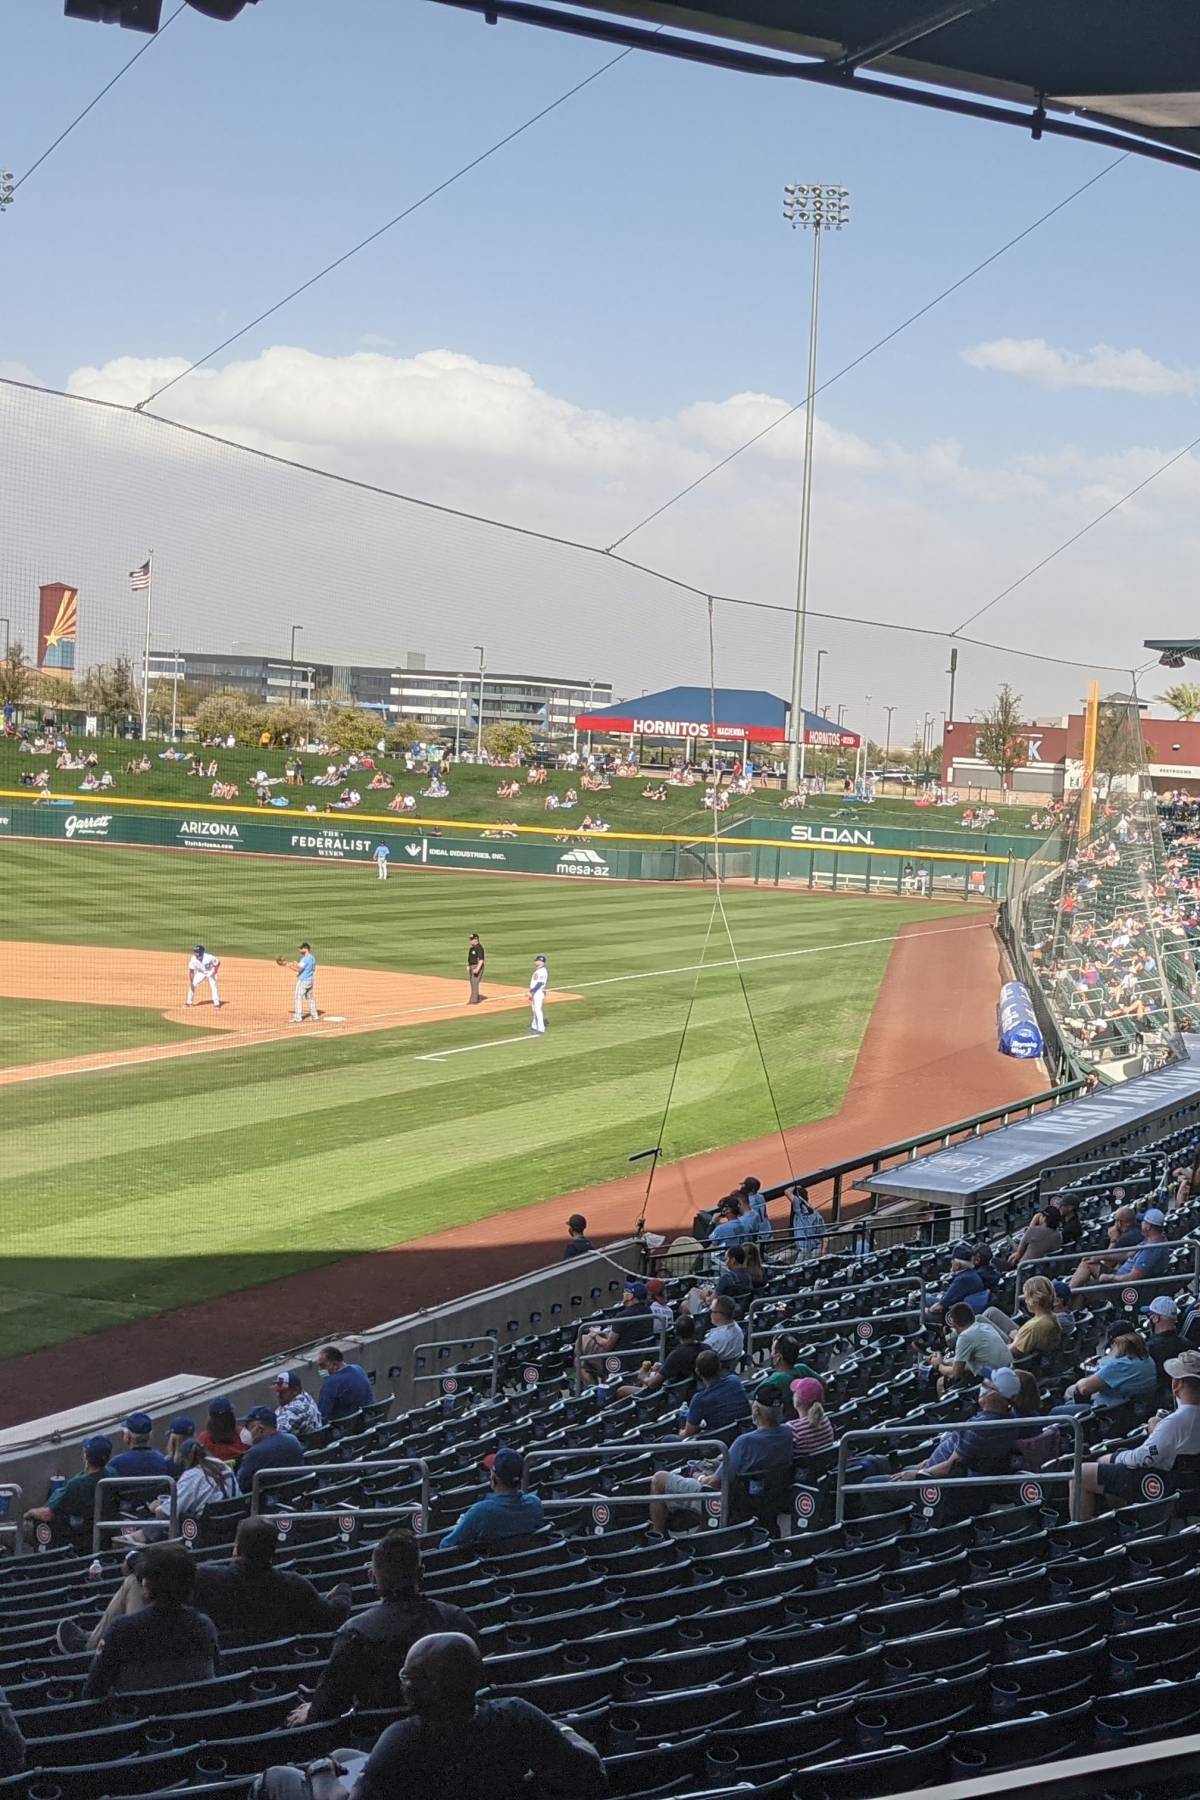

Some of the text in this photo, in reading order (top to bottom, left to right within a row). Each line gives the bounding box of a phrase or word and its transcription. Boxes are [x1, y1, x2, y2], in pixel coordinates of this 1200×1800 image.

[633, 719, 709, 738] HORNITOS
[808, 730, 841, 746] HORNITOS
[65, 815, 112, 838] Garrett
[180, 821, 239, 838] ARIZONA
[291, 836, 371, 852] FEDERALIST
[318, 849, 344, 857] WINES
[429, 848, 449, 857] IDEAL
[1018, 1104, 1135, 1134] MESA
